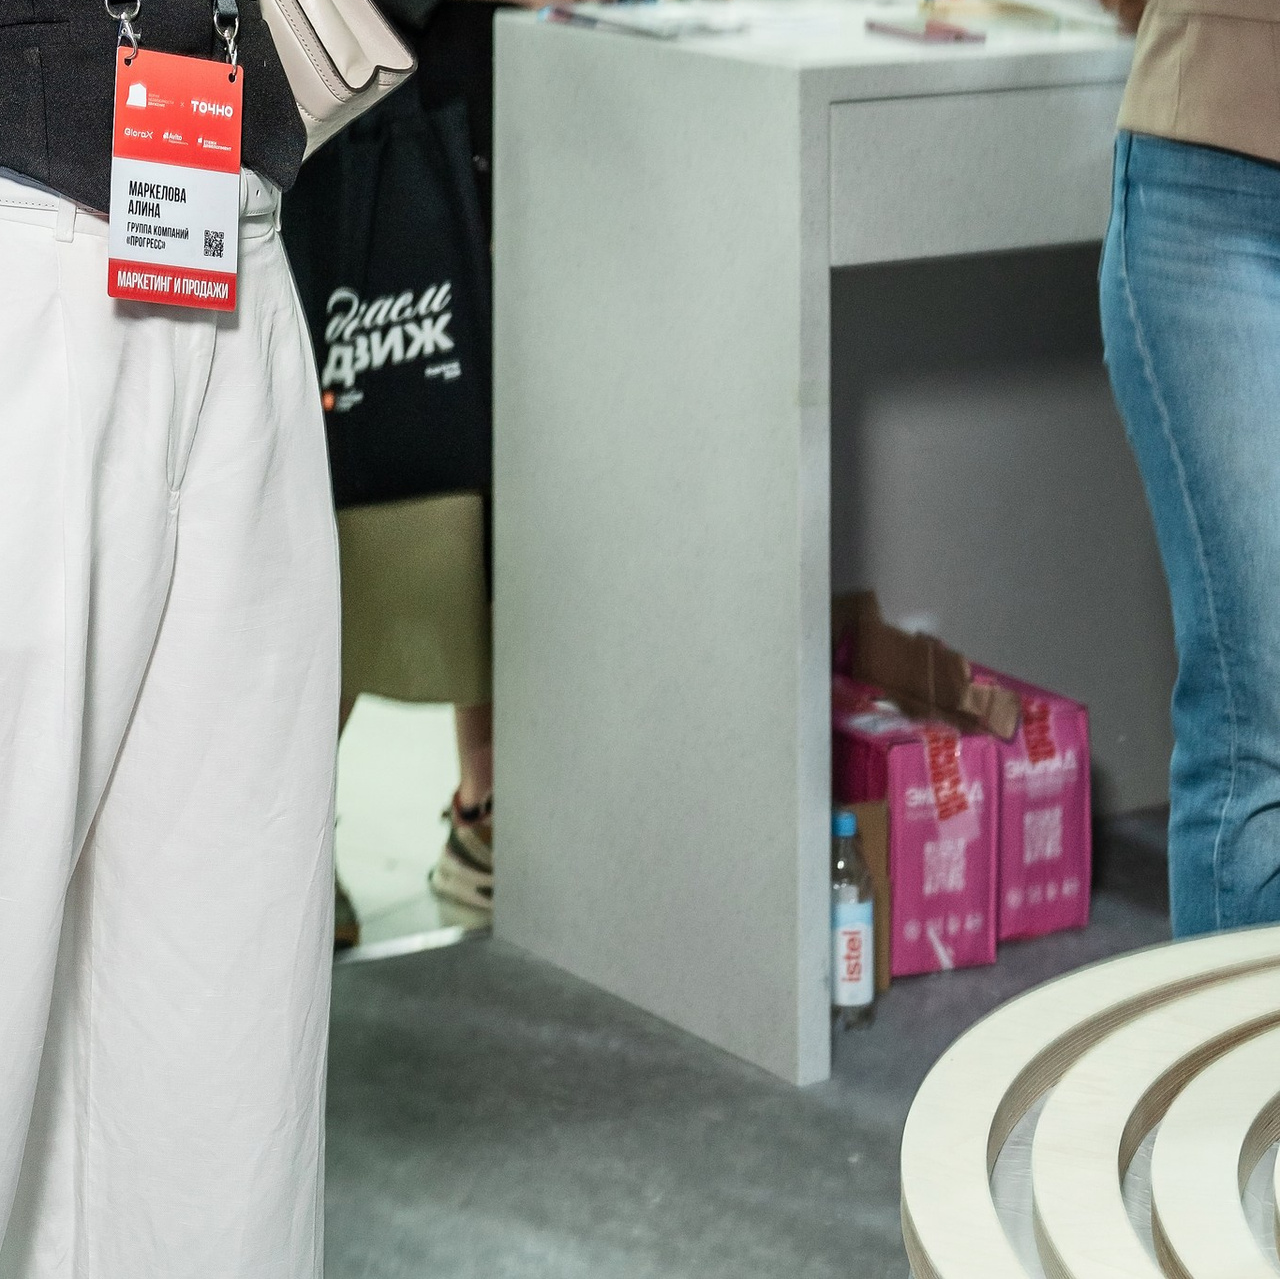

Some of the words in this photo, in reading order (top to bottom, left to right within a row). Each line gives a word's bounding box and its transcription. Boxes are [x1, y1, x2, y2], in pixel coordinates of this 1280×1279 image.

[190, 99, 234, 118] ТОЧНО
[124, 127, 154, 140] GloraX
[128, 180, 187, 204] МАРКЕЛОВА
[127, 199, 161, 219] АЛИНА
[126, 221, 152, 235] ГРУППА
[153, 225, 190, 240] КОМПАНИЙ
[117, 270, 173, 293] МАРКЕТИНГ
[173, 279, 182, 294] И
[182, 278, 229, 300] ПРОДАЖИ
